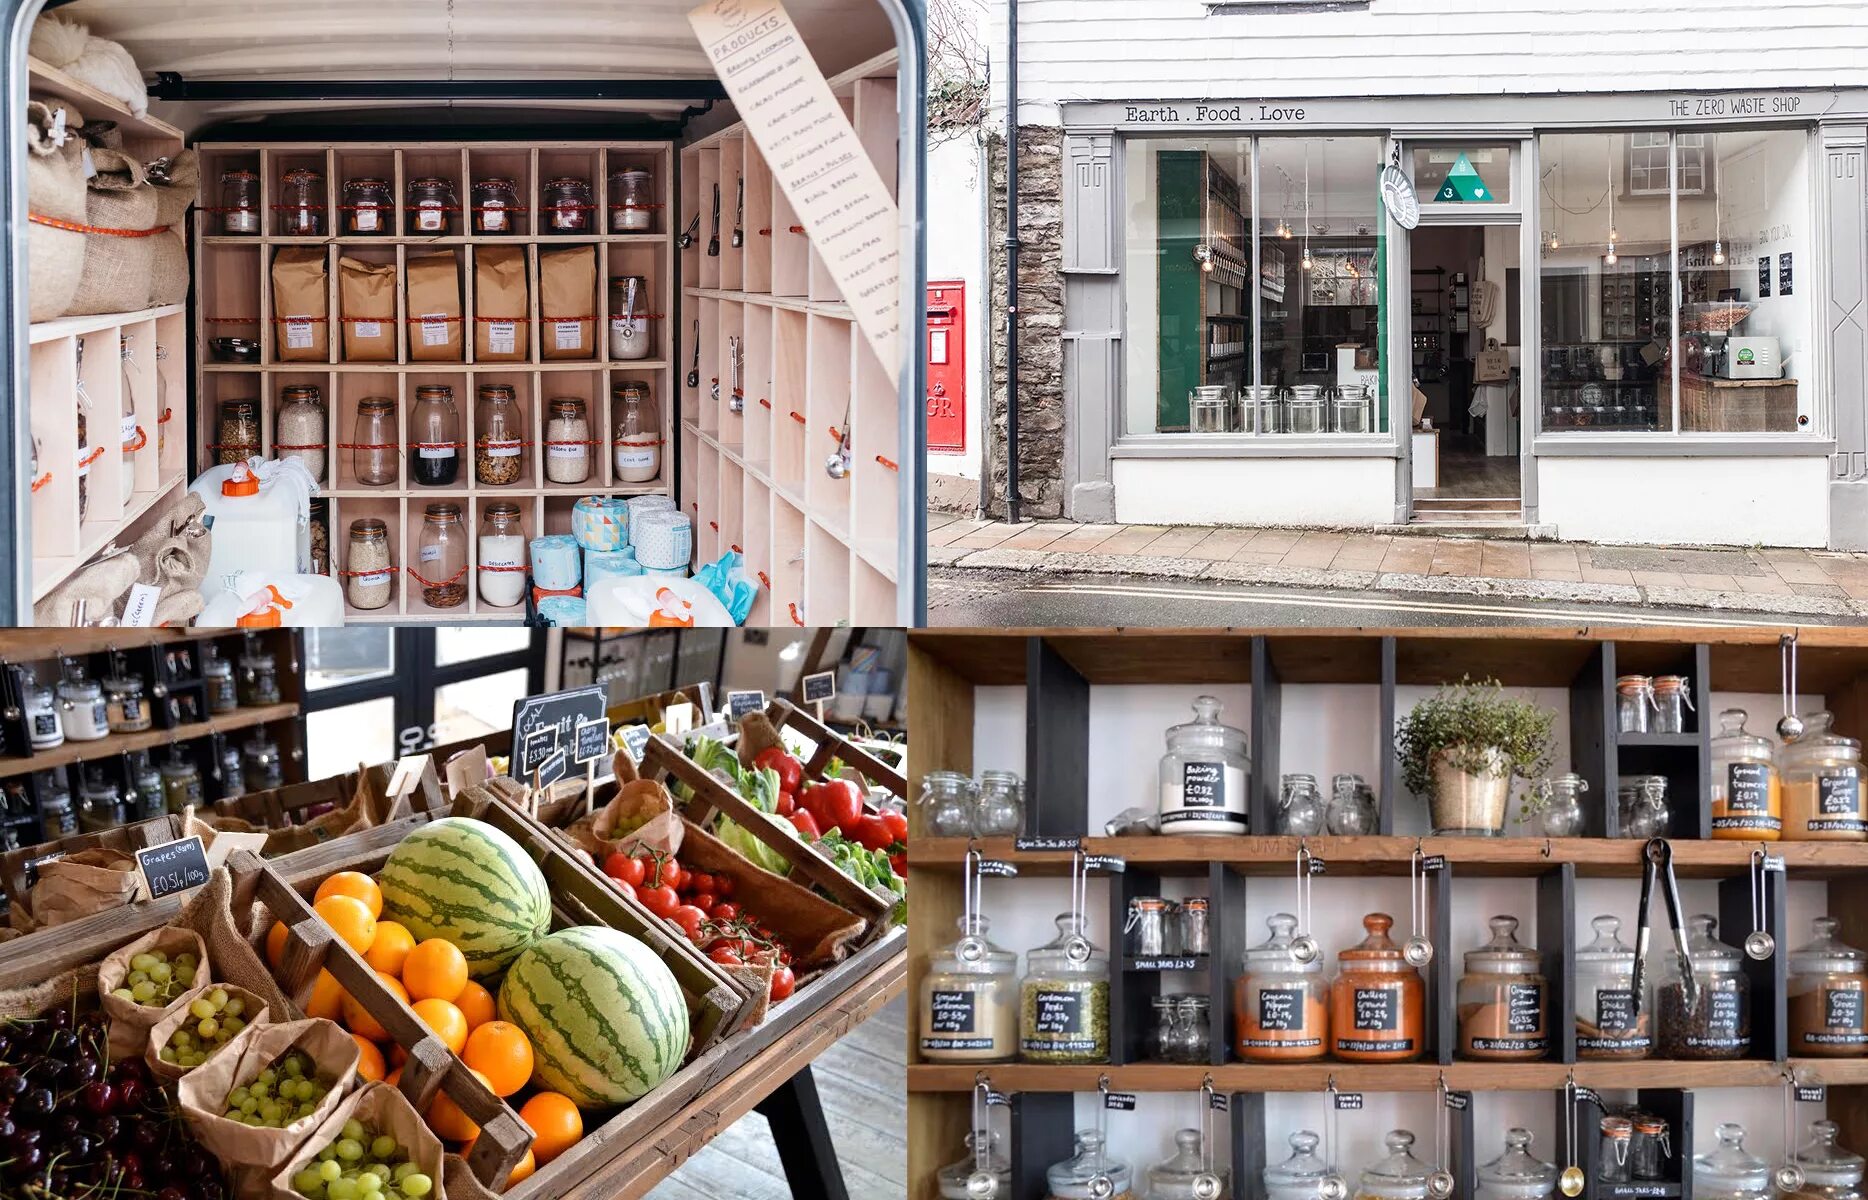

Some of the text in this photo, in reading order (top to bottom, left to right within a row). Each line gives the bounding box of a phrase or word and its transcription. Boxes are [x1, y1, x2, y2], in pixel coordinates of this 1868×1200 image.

[713, 15, 780, 60] PRODUCTS
[1125, 106, 1180, 122] Earth
[1195, 106, 1242, 122] Food
[1259, 105, 1306, 121] Love
[1668, 96, 1801, 116] THE ZERO WASTE SHOP
[926, 397, 956, 418] GR
[1186, 765, 1218, 776] Baking
[1186, 774, 1220, 784] powder
[142, 850, 177, 866] Grapes
